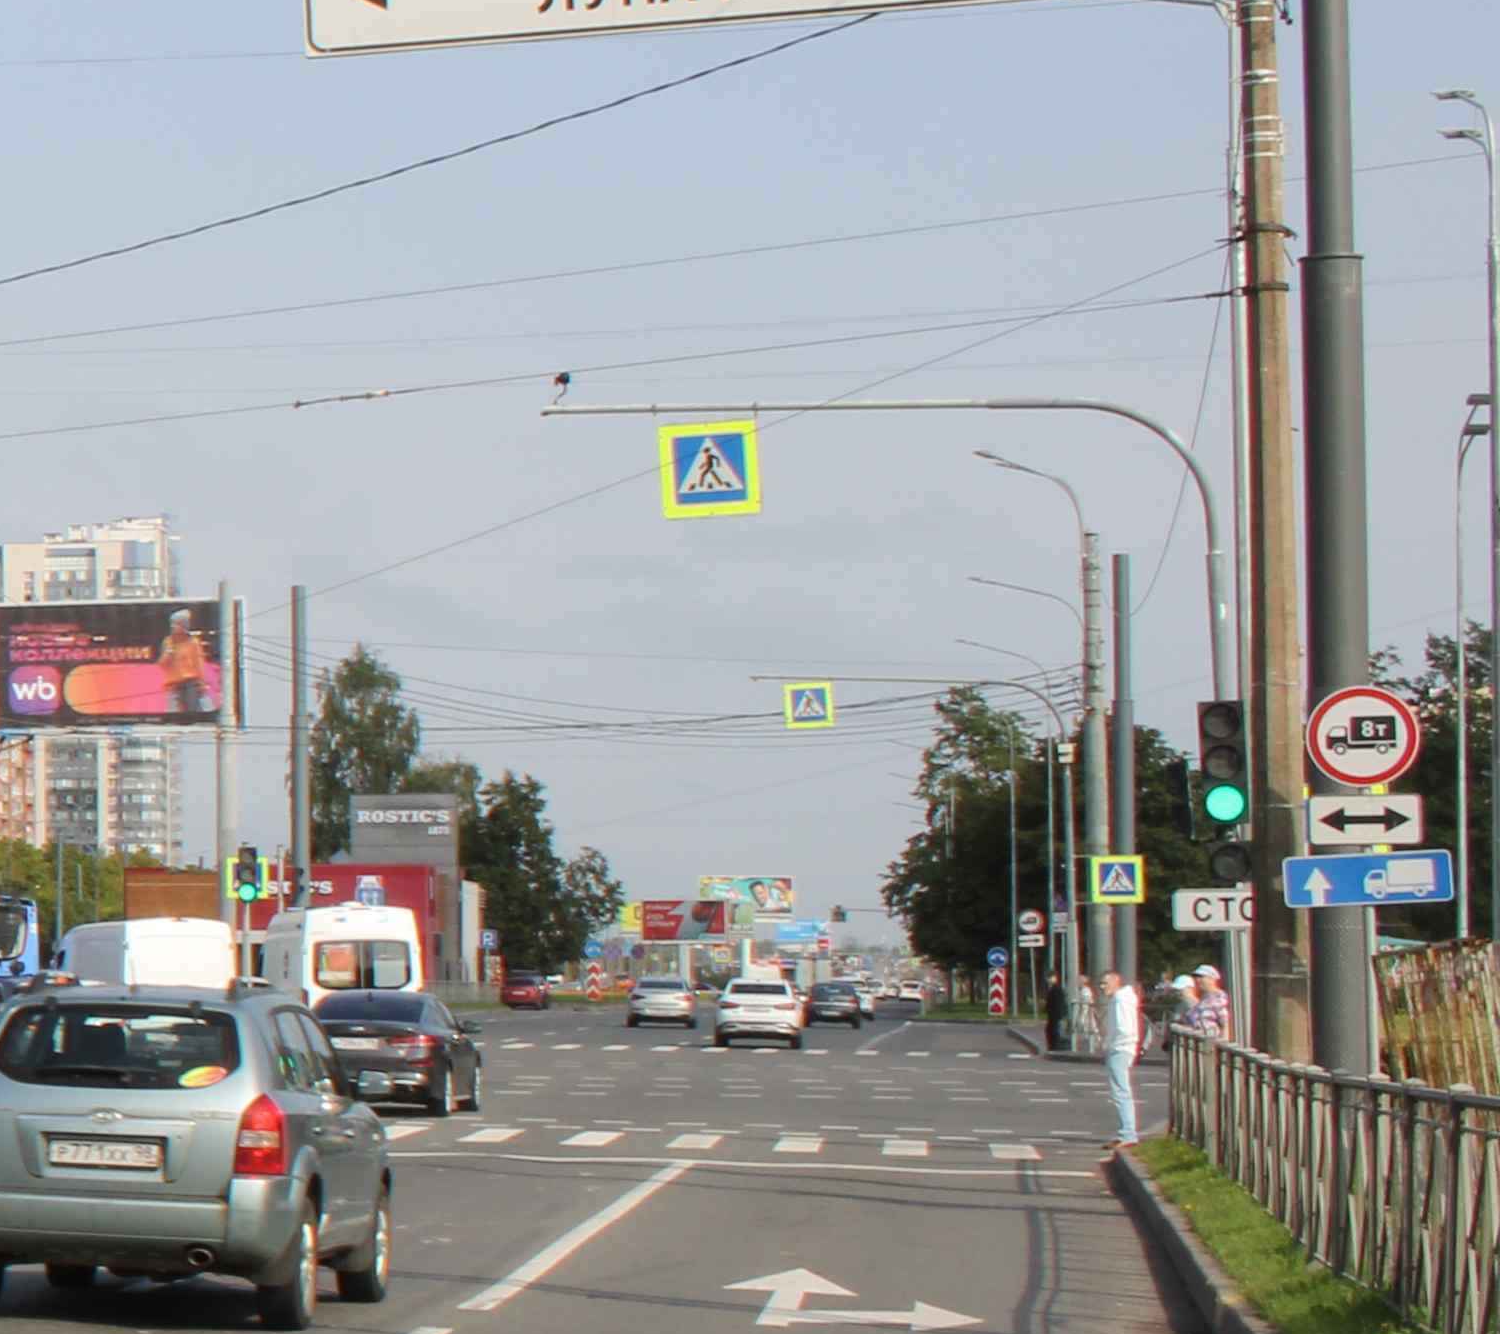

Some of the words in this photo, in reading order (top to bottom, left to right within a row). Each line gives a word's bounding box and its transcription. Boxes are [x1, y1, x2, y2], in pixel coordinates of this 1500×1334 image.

[12, 675, 57, 700] wb
[356, 809, 450, 824] ROSTIC'S
[1191, 896, 1253, 922] СТО
